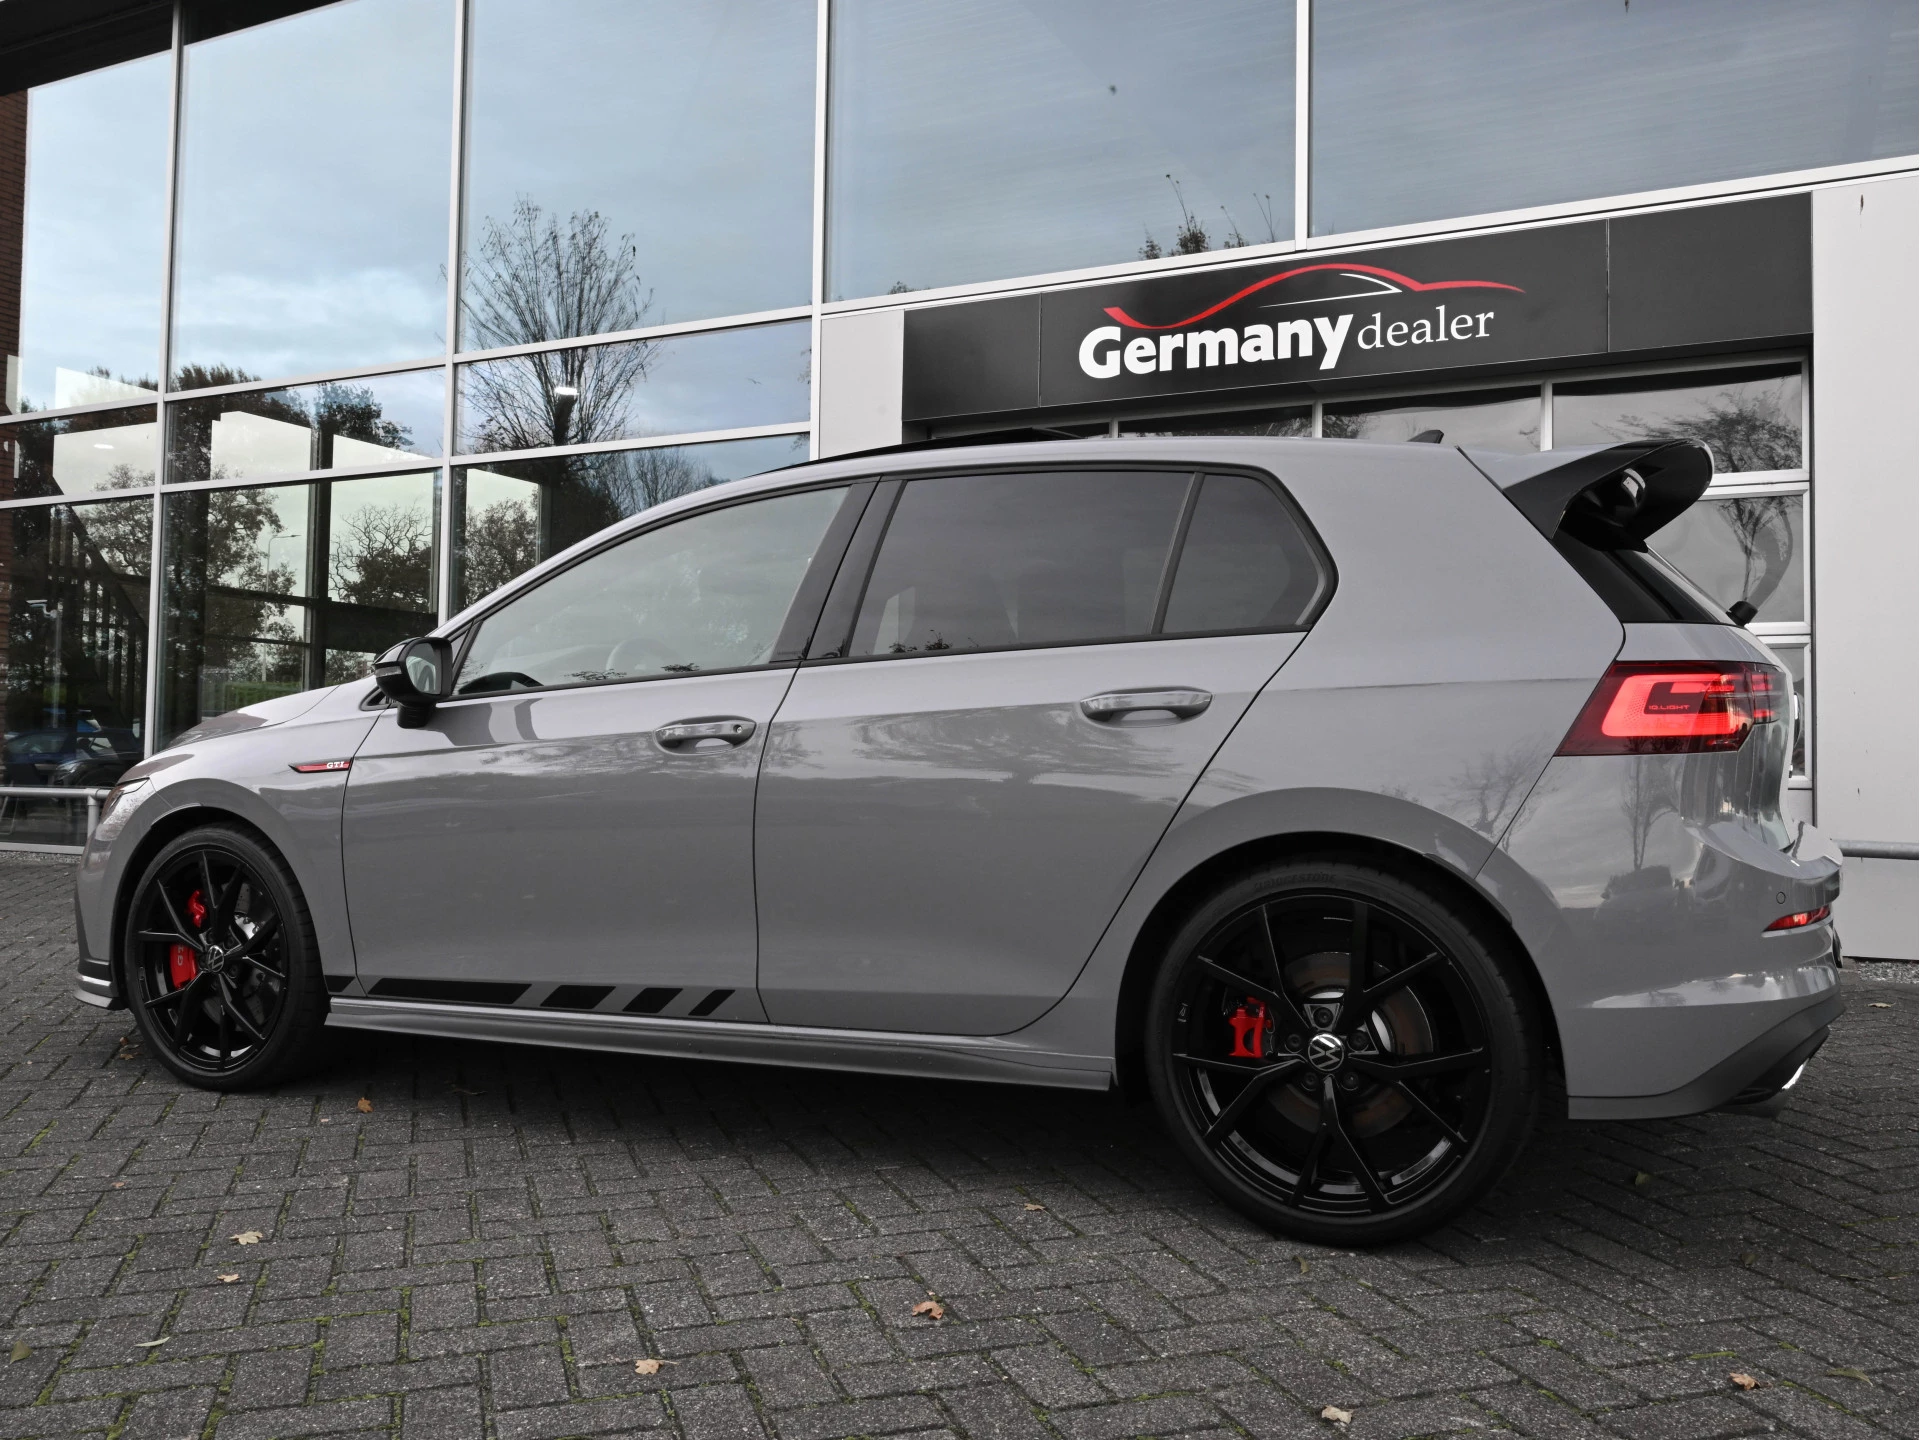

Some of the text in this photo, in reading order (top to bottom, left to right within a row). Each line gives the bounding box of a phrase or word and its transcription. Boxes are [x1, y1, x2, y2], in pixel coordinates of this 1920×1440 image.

[1079, 304, 1494, 379] Germany dealer
[326, 761, 345, 769] GTI
